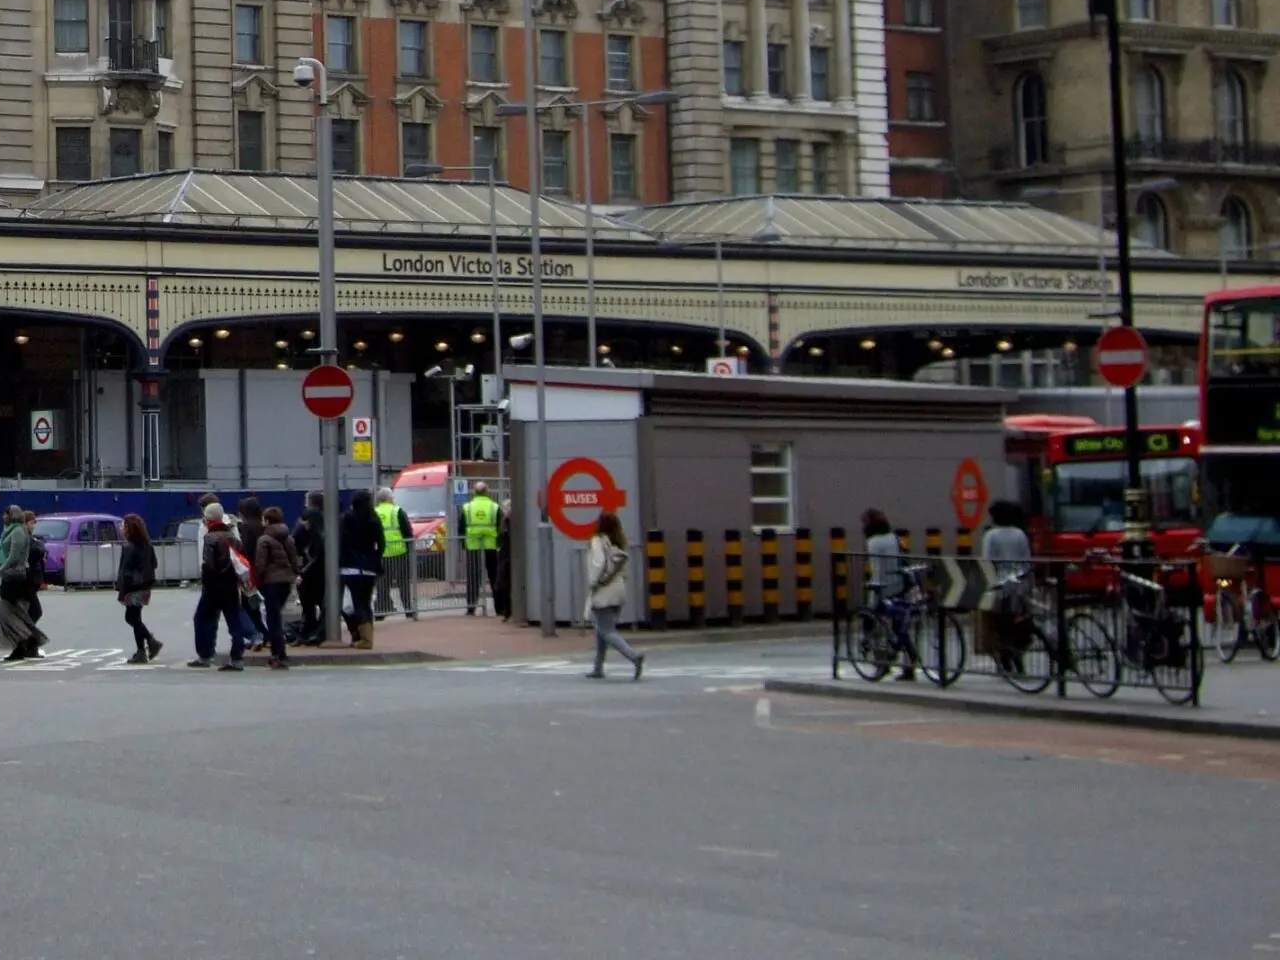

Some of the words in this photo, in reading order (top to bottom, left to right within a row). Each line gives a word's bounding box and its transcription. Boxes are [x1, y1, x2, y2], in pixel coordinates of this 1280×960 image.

[382, 252, 444, 273] London
[956, 269, 1007, 288] London
[1011, 271, 1064, 289] Victoria
[1067, 272, 1113, 290] Station
[564, 493, 598, 504] BUSES
